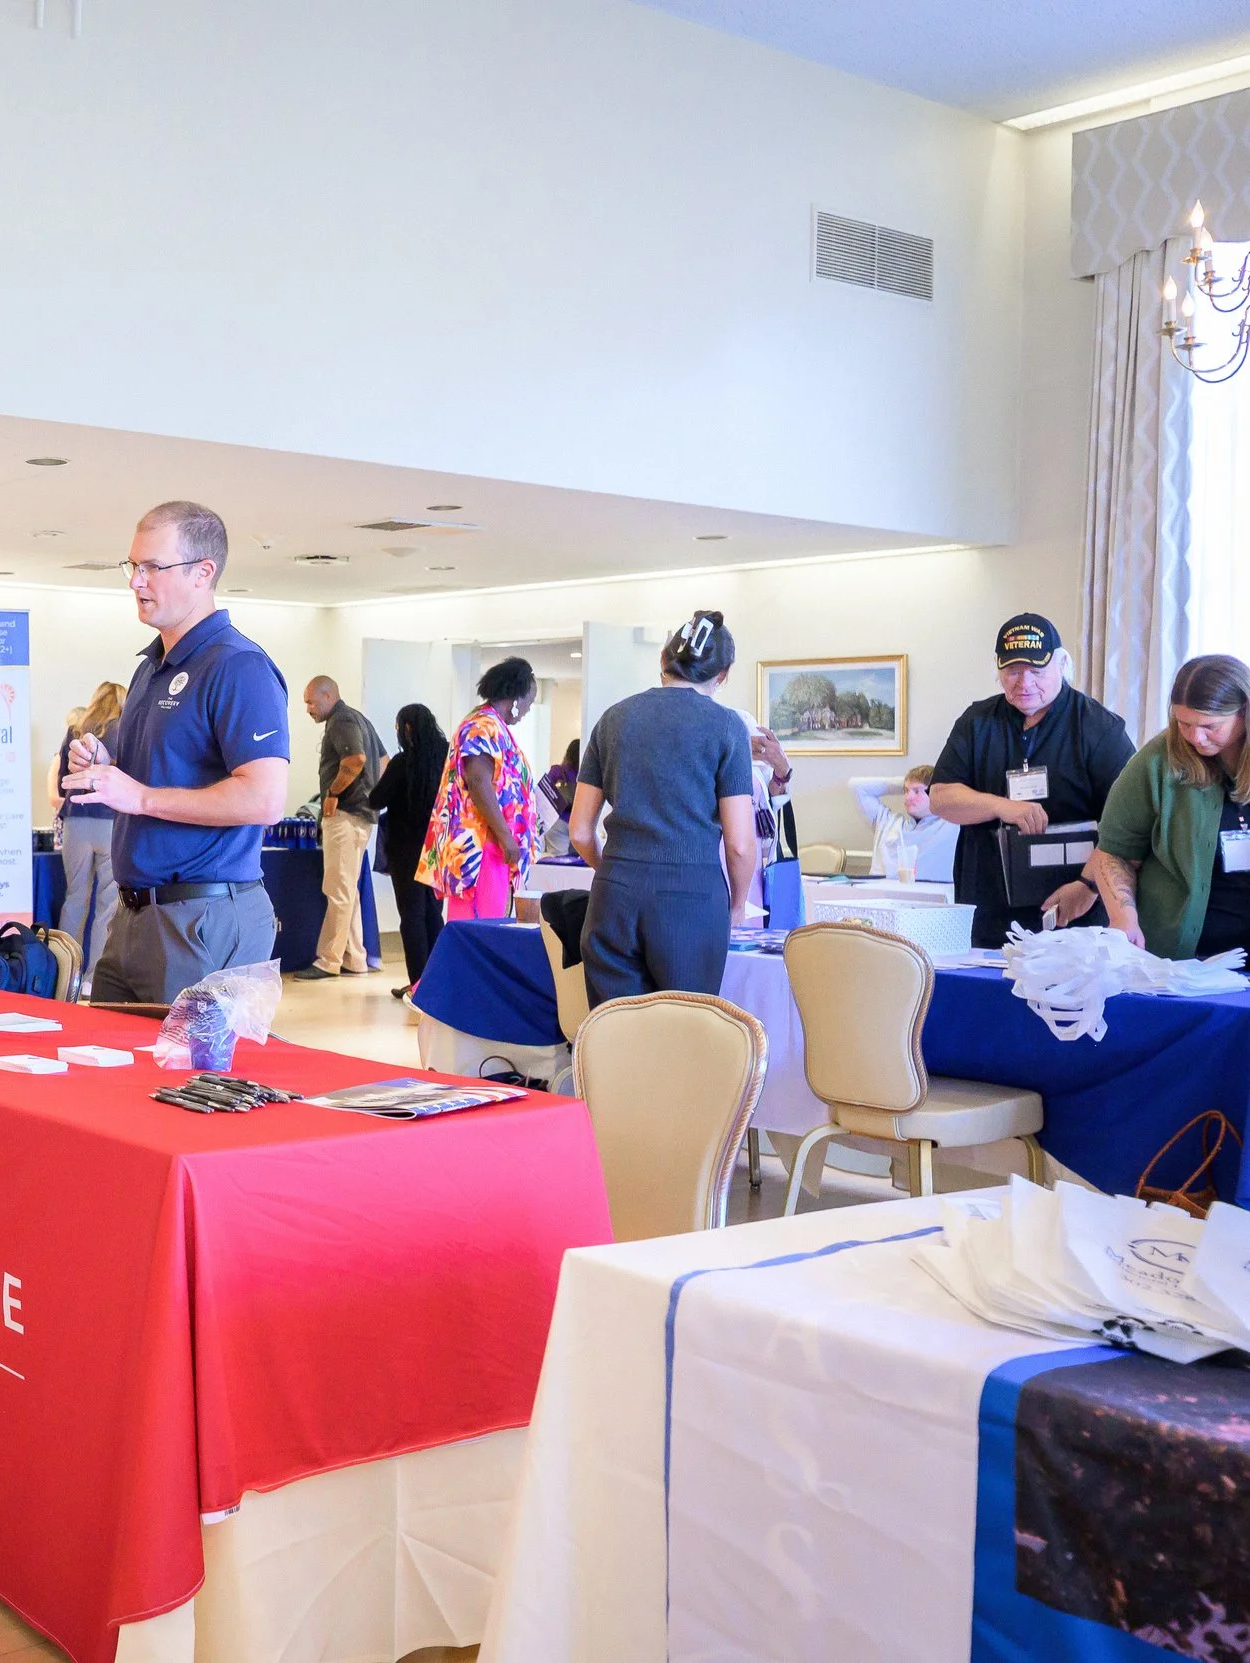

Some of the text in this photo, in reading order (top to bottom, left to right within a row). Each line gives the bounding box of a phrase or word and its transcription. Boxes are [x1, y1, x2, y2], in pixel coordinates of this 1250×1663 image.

[1003, 625, 1045, 639] VIETNAM WAR
[1004, 640, 1042, 650] VETERAN
